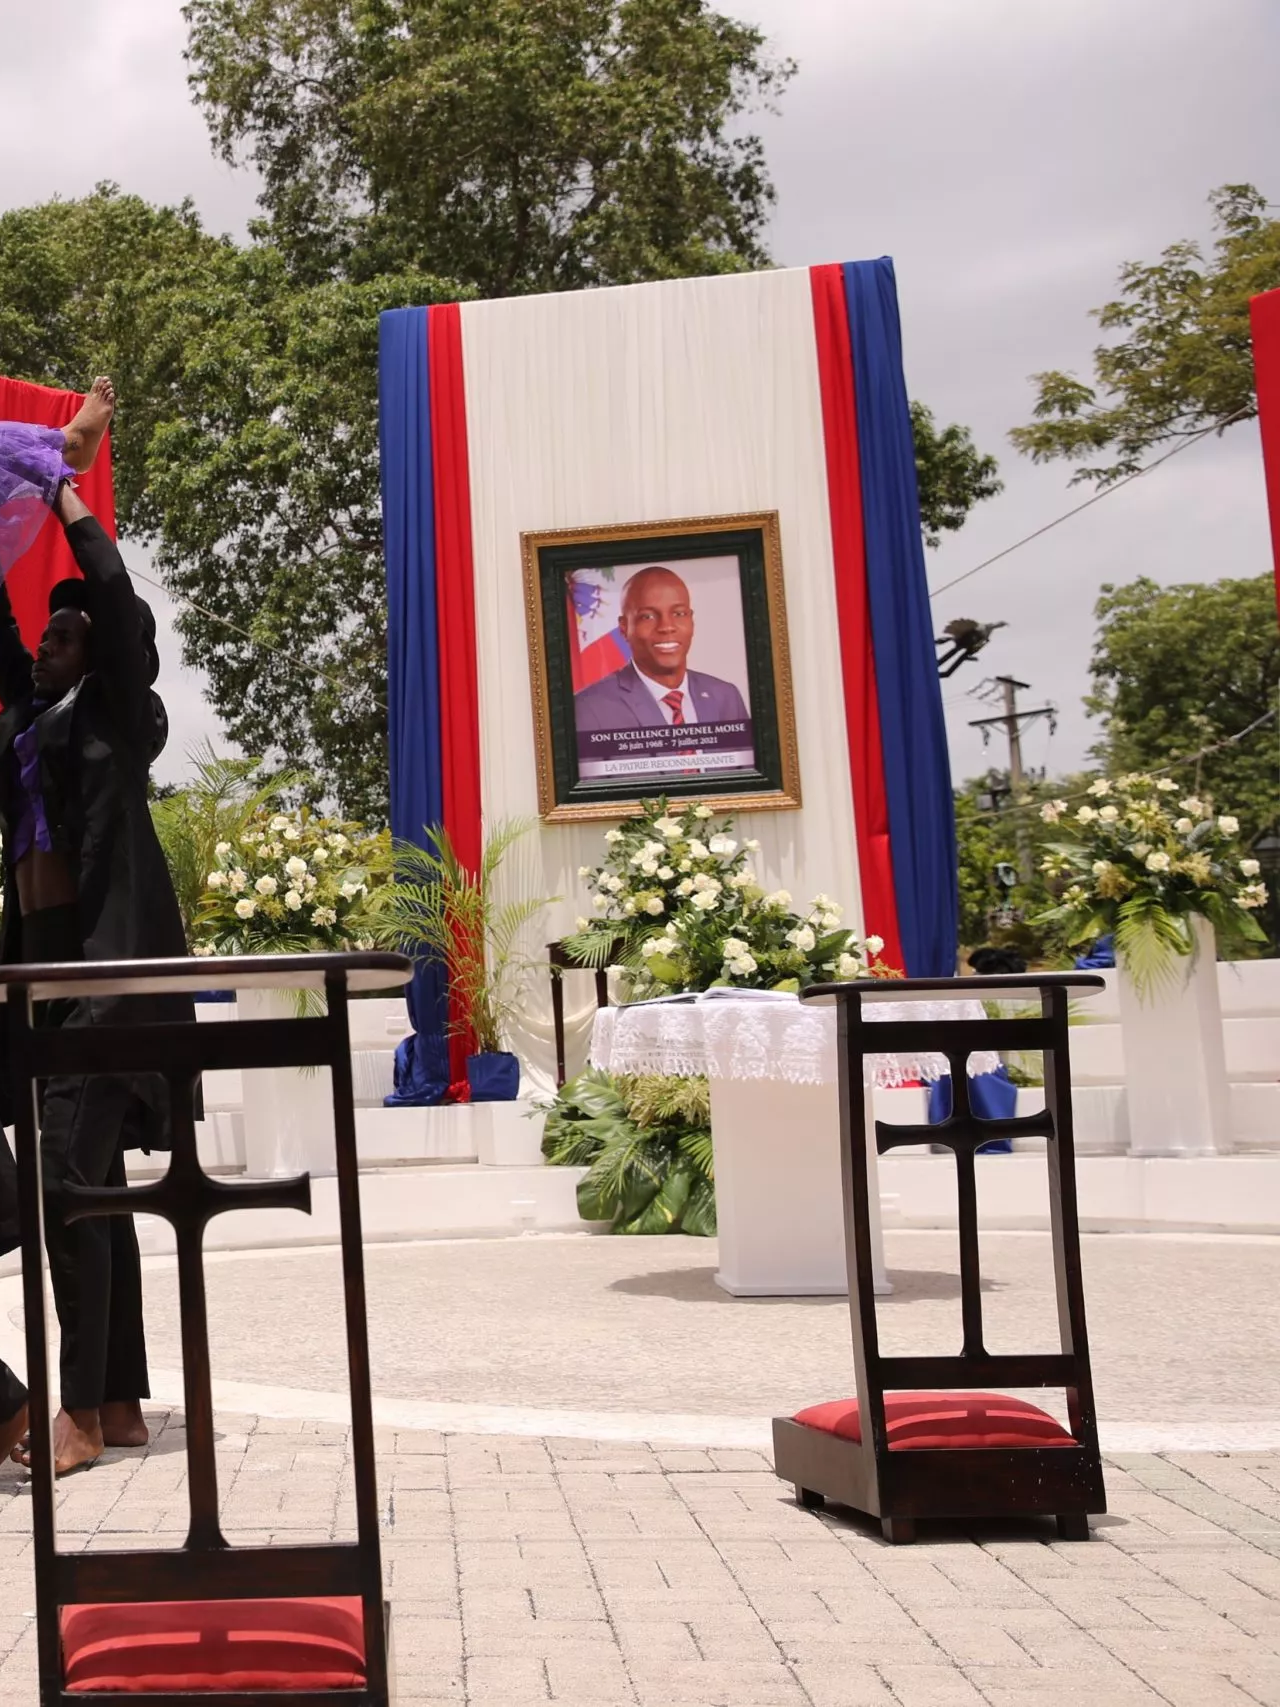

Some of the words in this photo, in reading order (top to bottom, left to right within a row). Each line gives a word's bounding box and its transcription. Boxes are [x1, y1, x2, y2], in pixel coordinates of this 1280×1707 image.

[590, 732, 611, 743] SON
[613, 728, 670, 741] EXCELLENCE
[672, 725, 713, 738] JOVENEL
[715, 723, 746, 733] MOISE
[618, 742, 628, 751] 26
[629, 741, 644, 752] juin
[645, 740, 664, 749] 1968
[671, 739, 677, 747] 7
[678, 737, 699, 748] juillet
[700, 736, 718, 745] 2021
[604, 763, 618, 772] LA
[619, 760, 649, 771] PATRIE
[650, 755, 736, 769] RECONNAISSANTE
